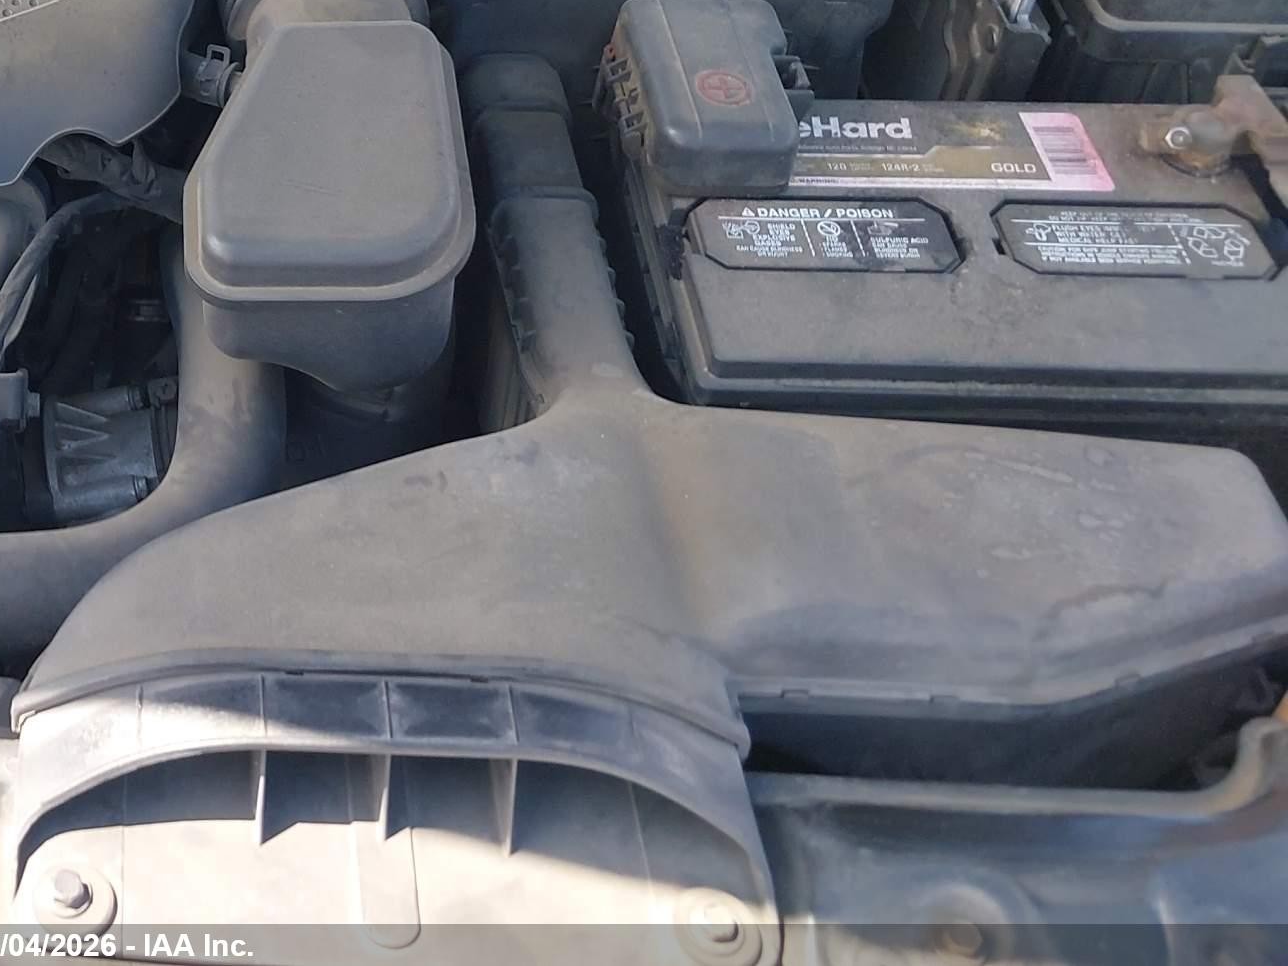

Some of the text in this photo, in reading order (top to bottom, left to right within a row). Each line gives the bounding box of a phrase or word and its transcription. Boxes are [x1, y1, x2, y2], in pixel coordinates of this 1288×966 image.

[991, 162, 1037, 173] GOLD
[757, 207, 894, 219] DANGER / POISON
